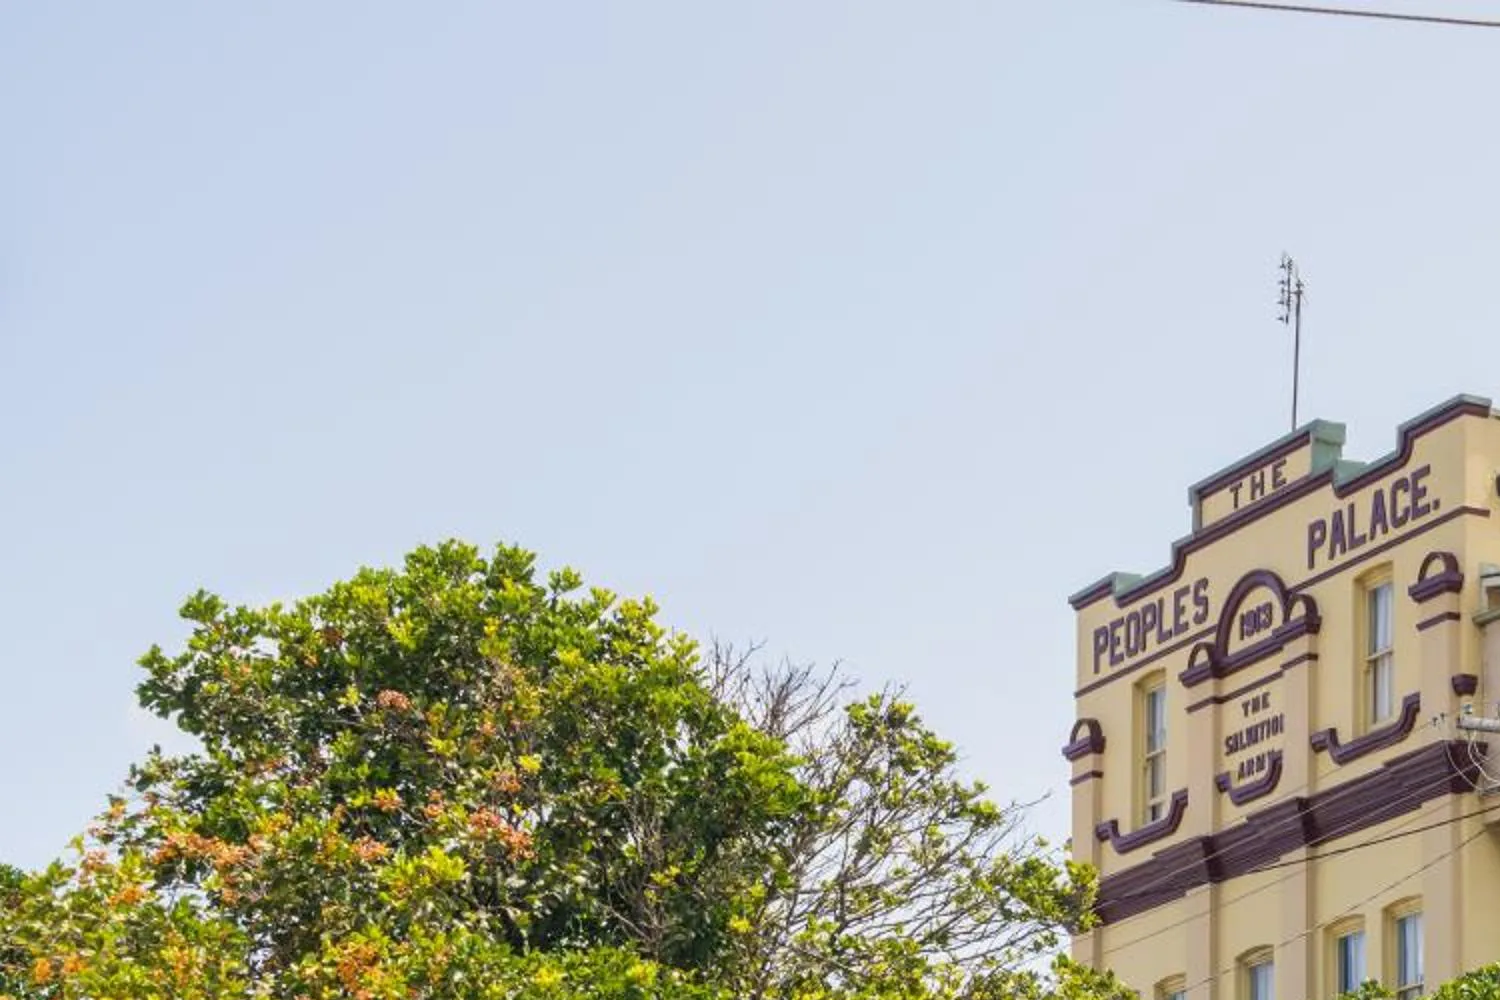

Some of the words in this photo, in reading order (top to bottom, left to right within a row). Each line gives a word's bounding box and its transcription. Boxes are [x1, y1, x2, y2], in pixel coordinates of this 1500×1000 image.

[1229, 459, 1287, 509] THE
[1093, 577, 1209, 674] PEOPLES
[1307, 463, 1440, 570] PALACE.
[1242, 691, 1271, 717] THE
[1238, 749, 1275, 781] ARM
